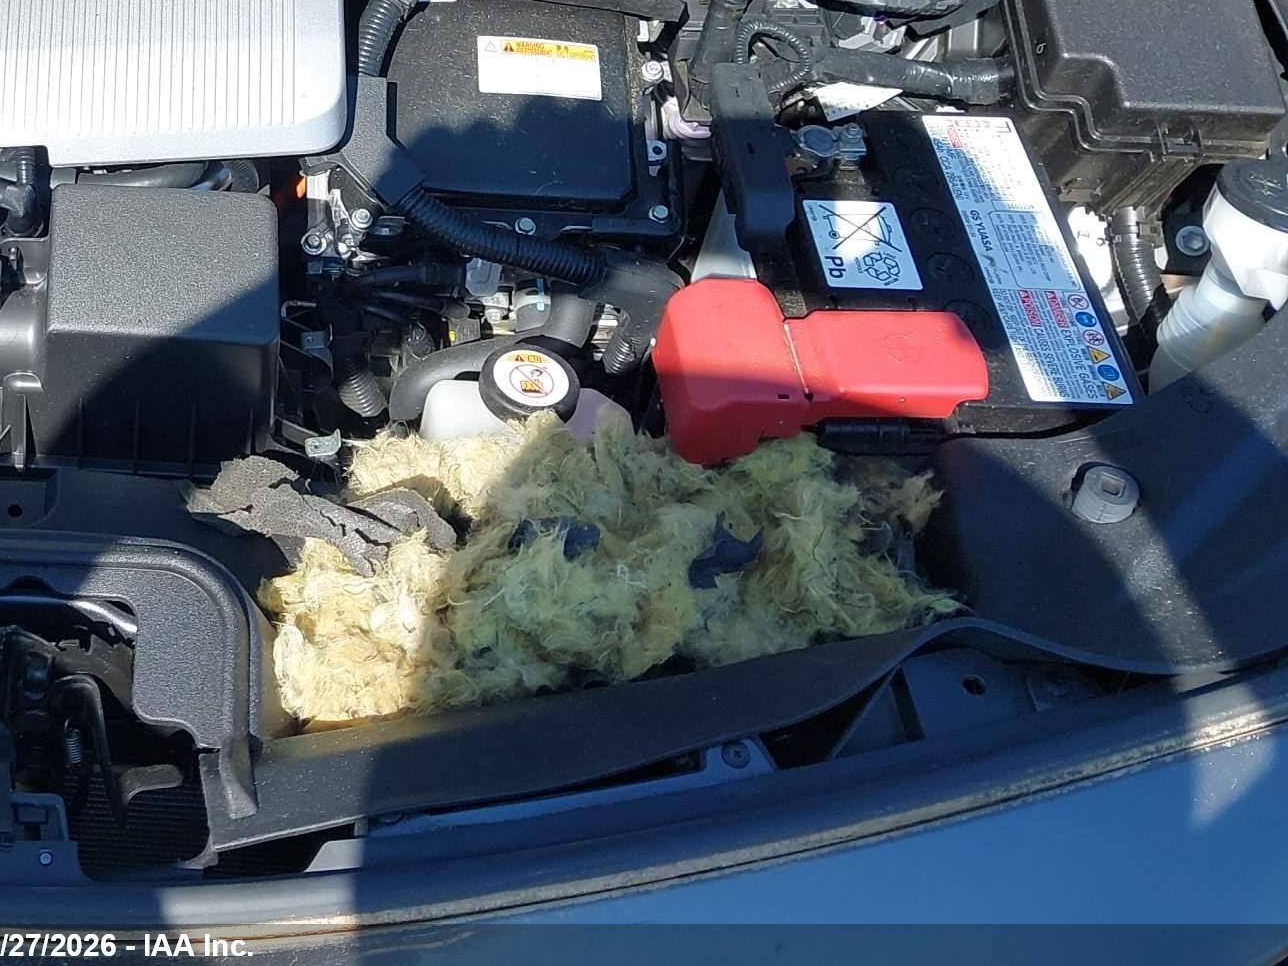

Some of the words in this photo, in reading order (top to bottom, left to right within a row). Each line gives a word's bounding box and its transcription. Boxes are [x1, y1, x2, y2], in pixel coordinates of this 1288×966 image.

[976, 221, 993, 251] YUASA
[824, 256, 847, 278] Pb
[1022, 297, 1042, 326] POISON
[1033, 328, 1051, 351] CAUSES
[1044, 351, 1061, 376] SEVERE
[1054, 377, 1070, 398] BURNS
[1061, 329, 1086, 371] EXPLOSIVE
[1079, 373, 1098, 399] GASES
